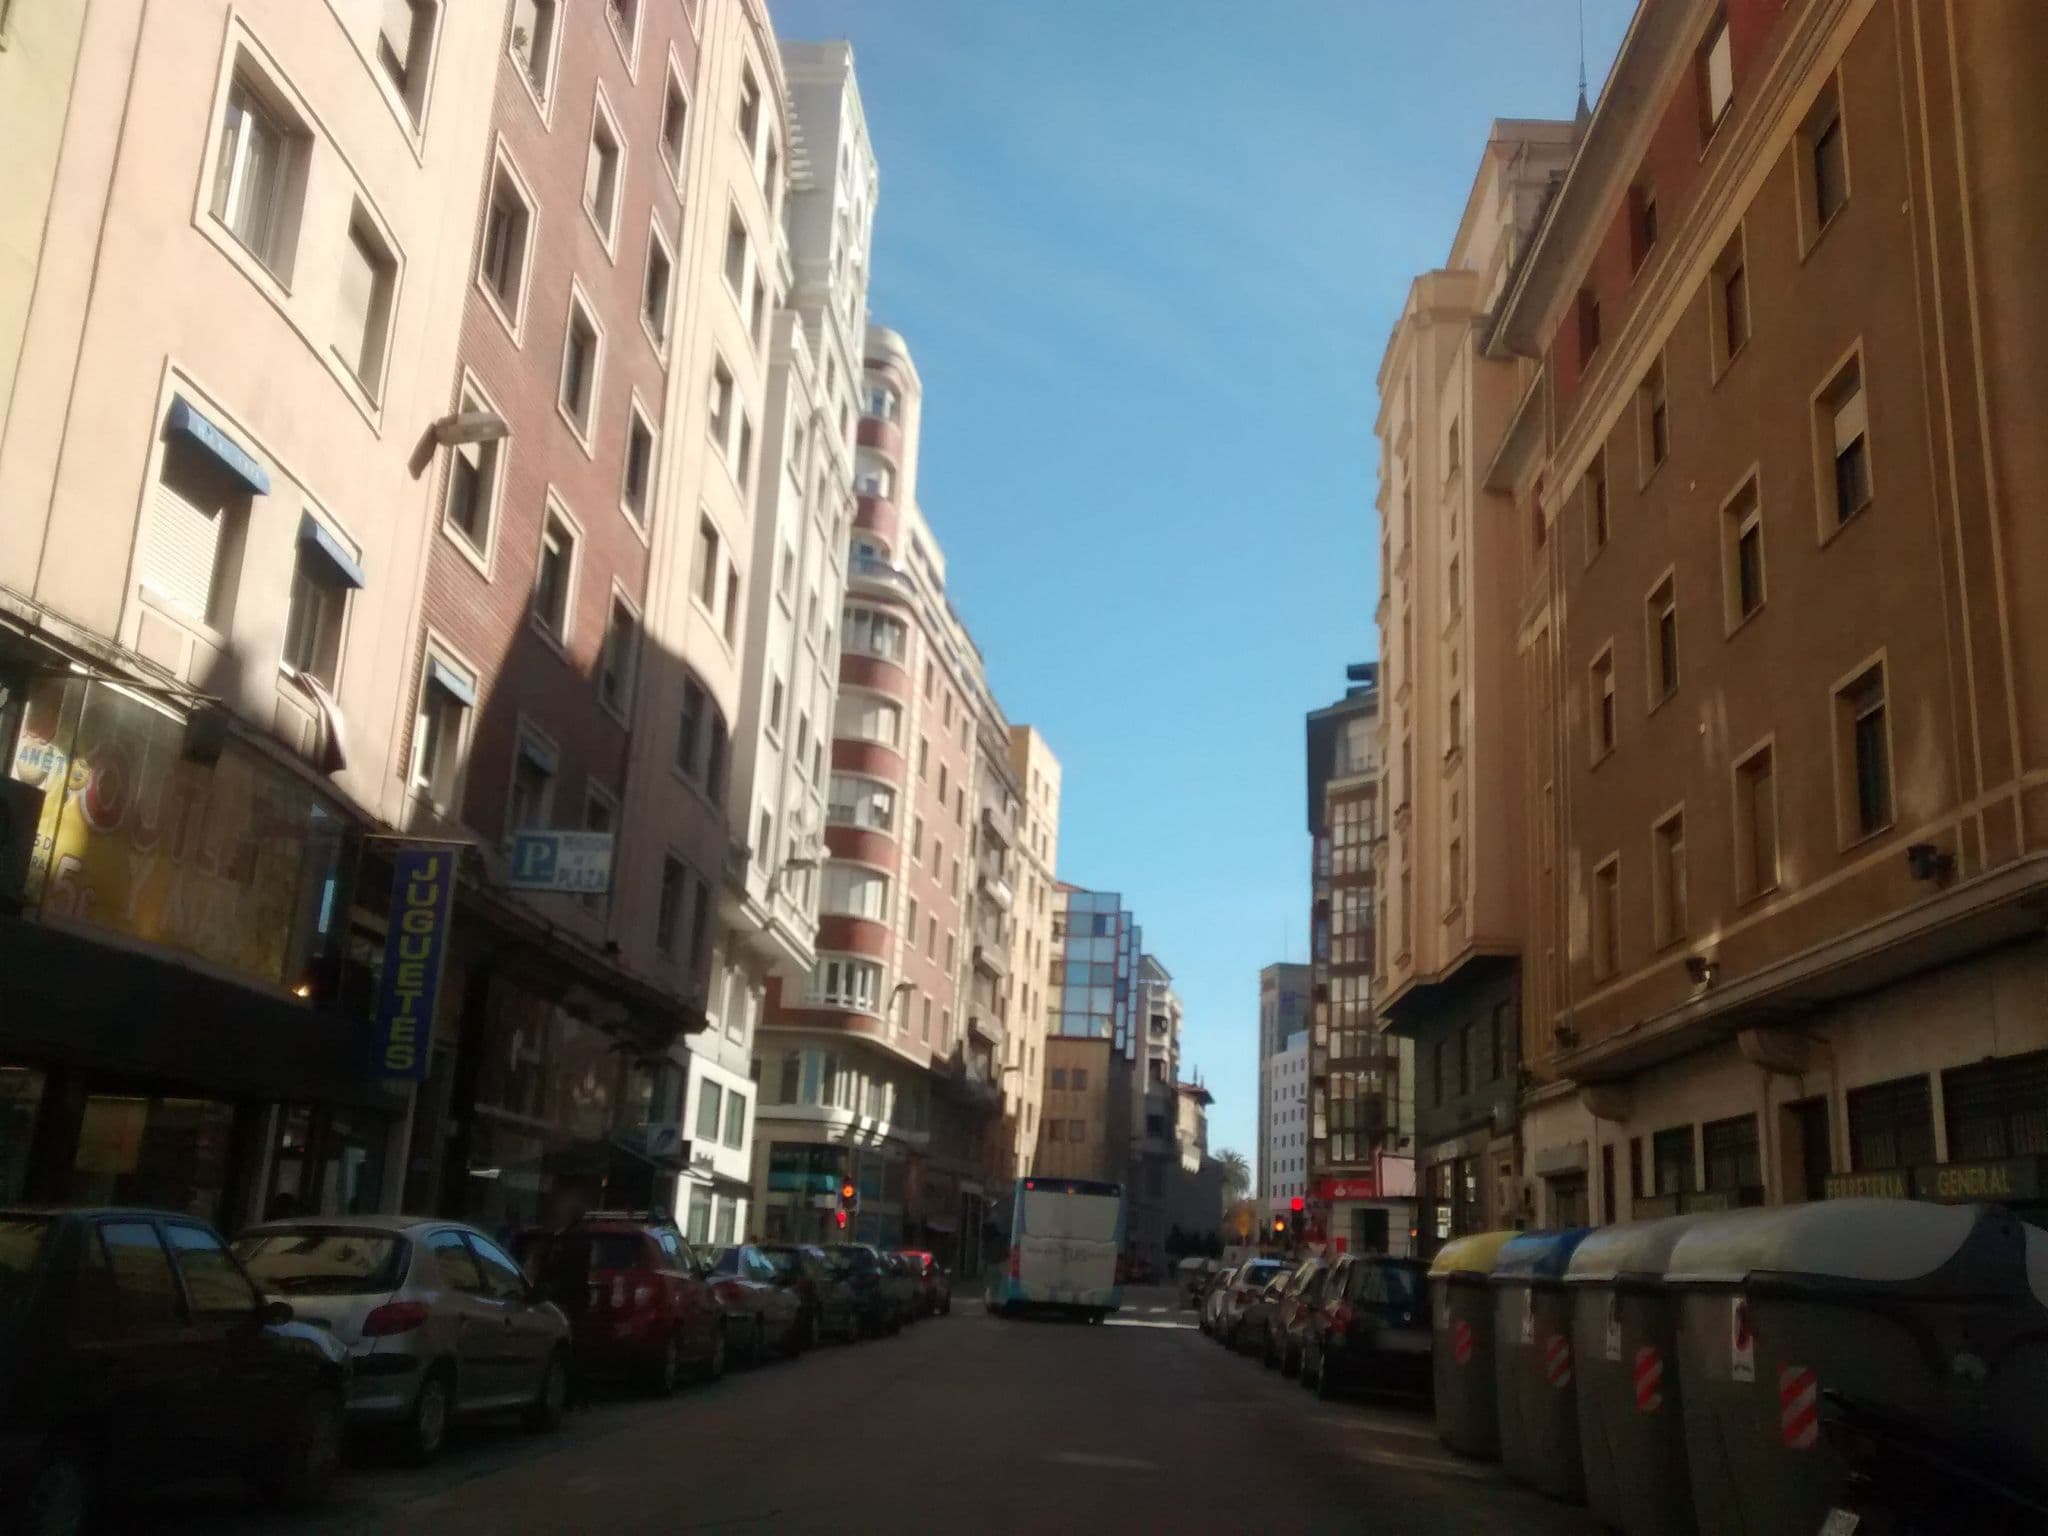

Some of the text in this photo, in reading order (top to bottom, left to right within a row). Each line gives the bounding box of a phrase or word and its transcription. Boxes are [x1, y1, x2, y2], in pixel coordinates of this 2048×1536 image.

[517, 841, 551, 876] P
[385, 855, 440, 1071] JUGUETES
[1936, 1167, 2011, 1197] GENERAL
